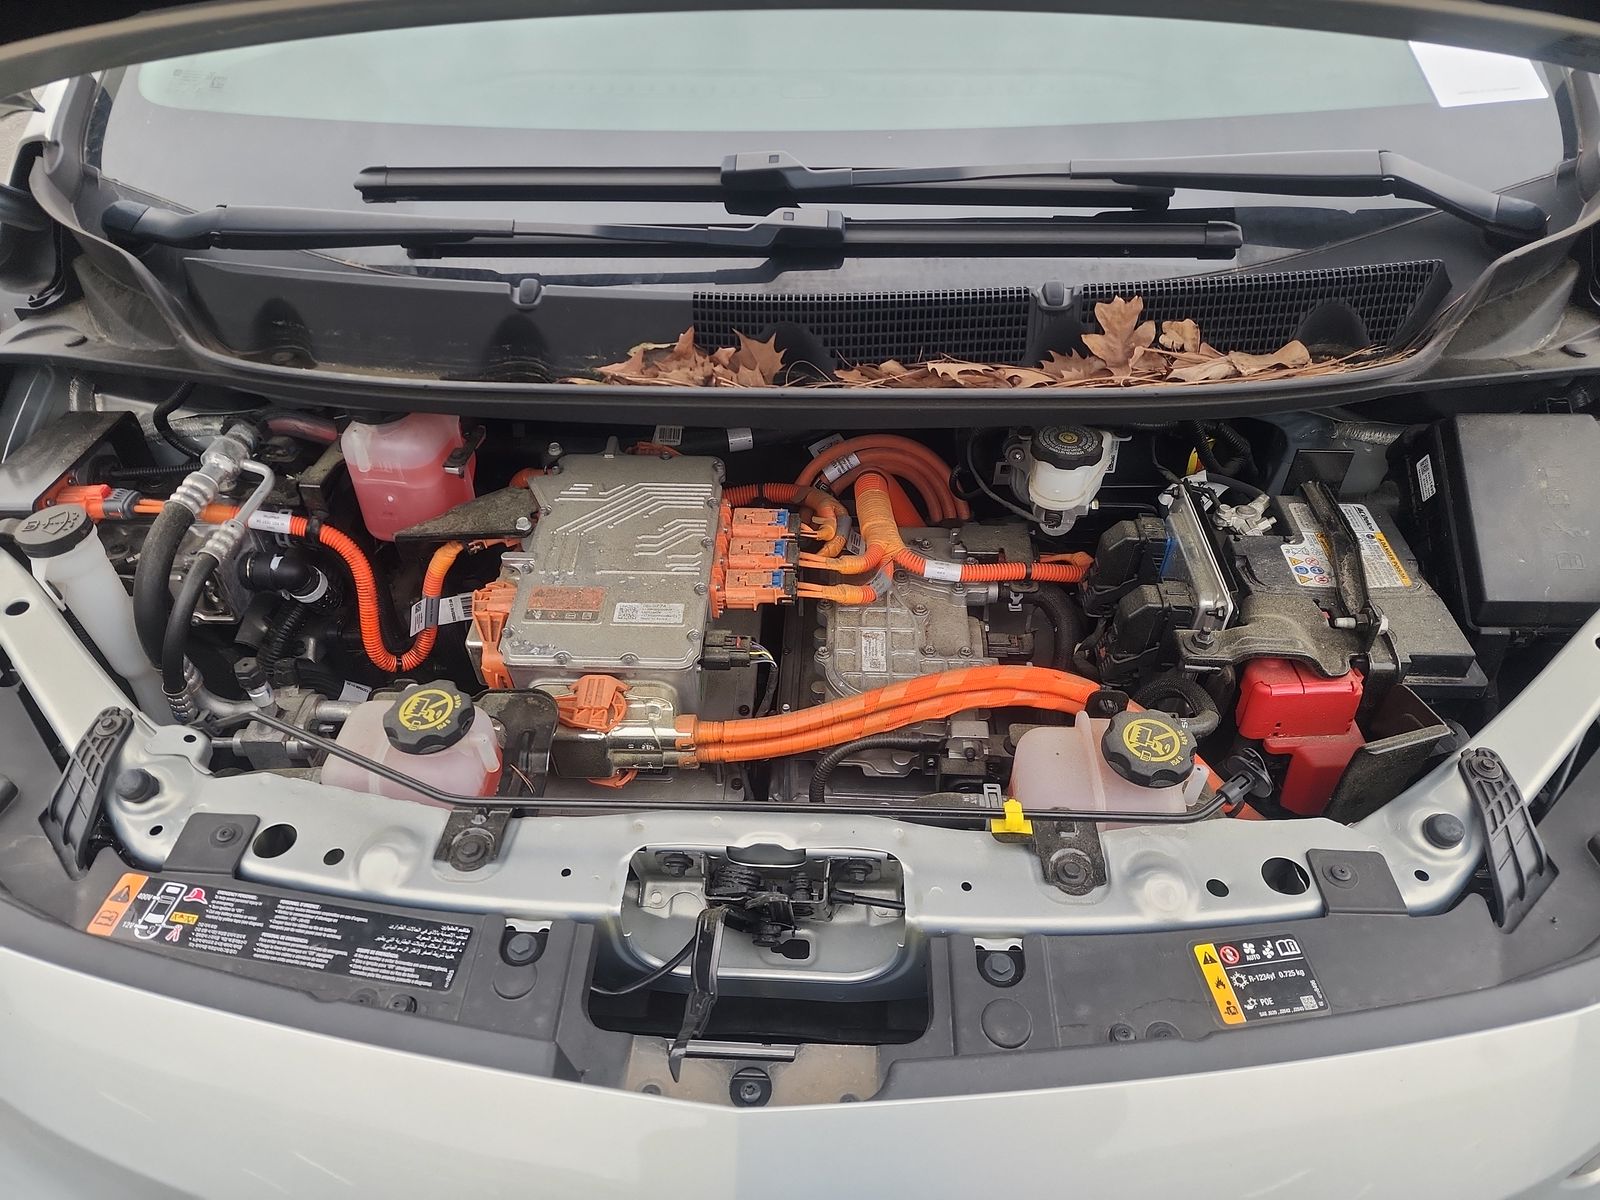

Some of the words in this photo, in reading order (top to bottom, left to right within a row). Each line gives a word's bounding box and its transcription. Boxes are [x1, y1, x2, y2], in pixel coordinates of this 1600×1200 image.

[1248, 972, 1276, 983] R-1234yf
[1278, 970, 1296, 978] 0.725
[1260, 998, 1274, 1006] POE
